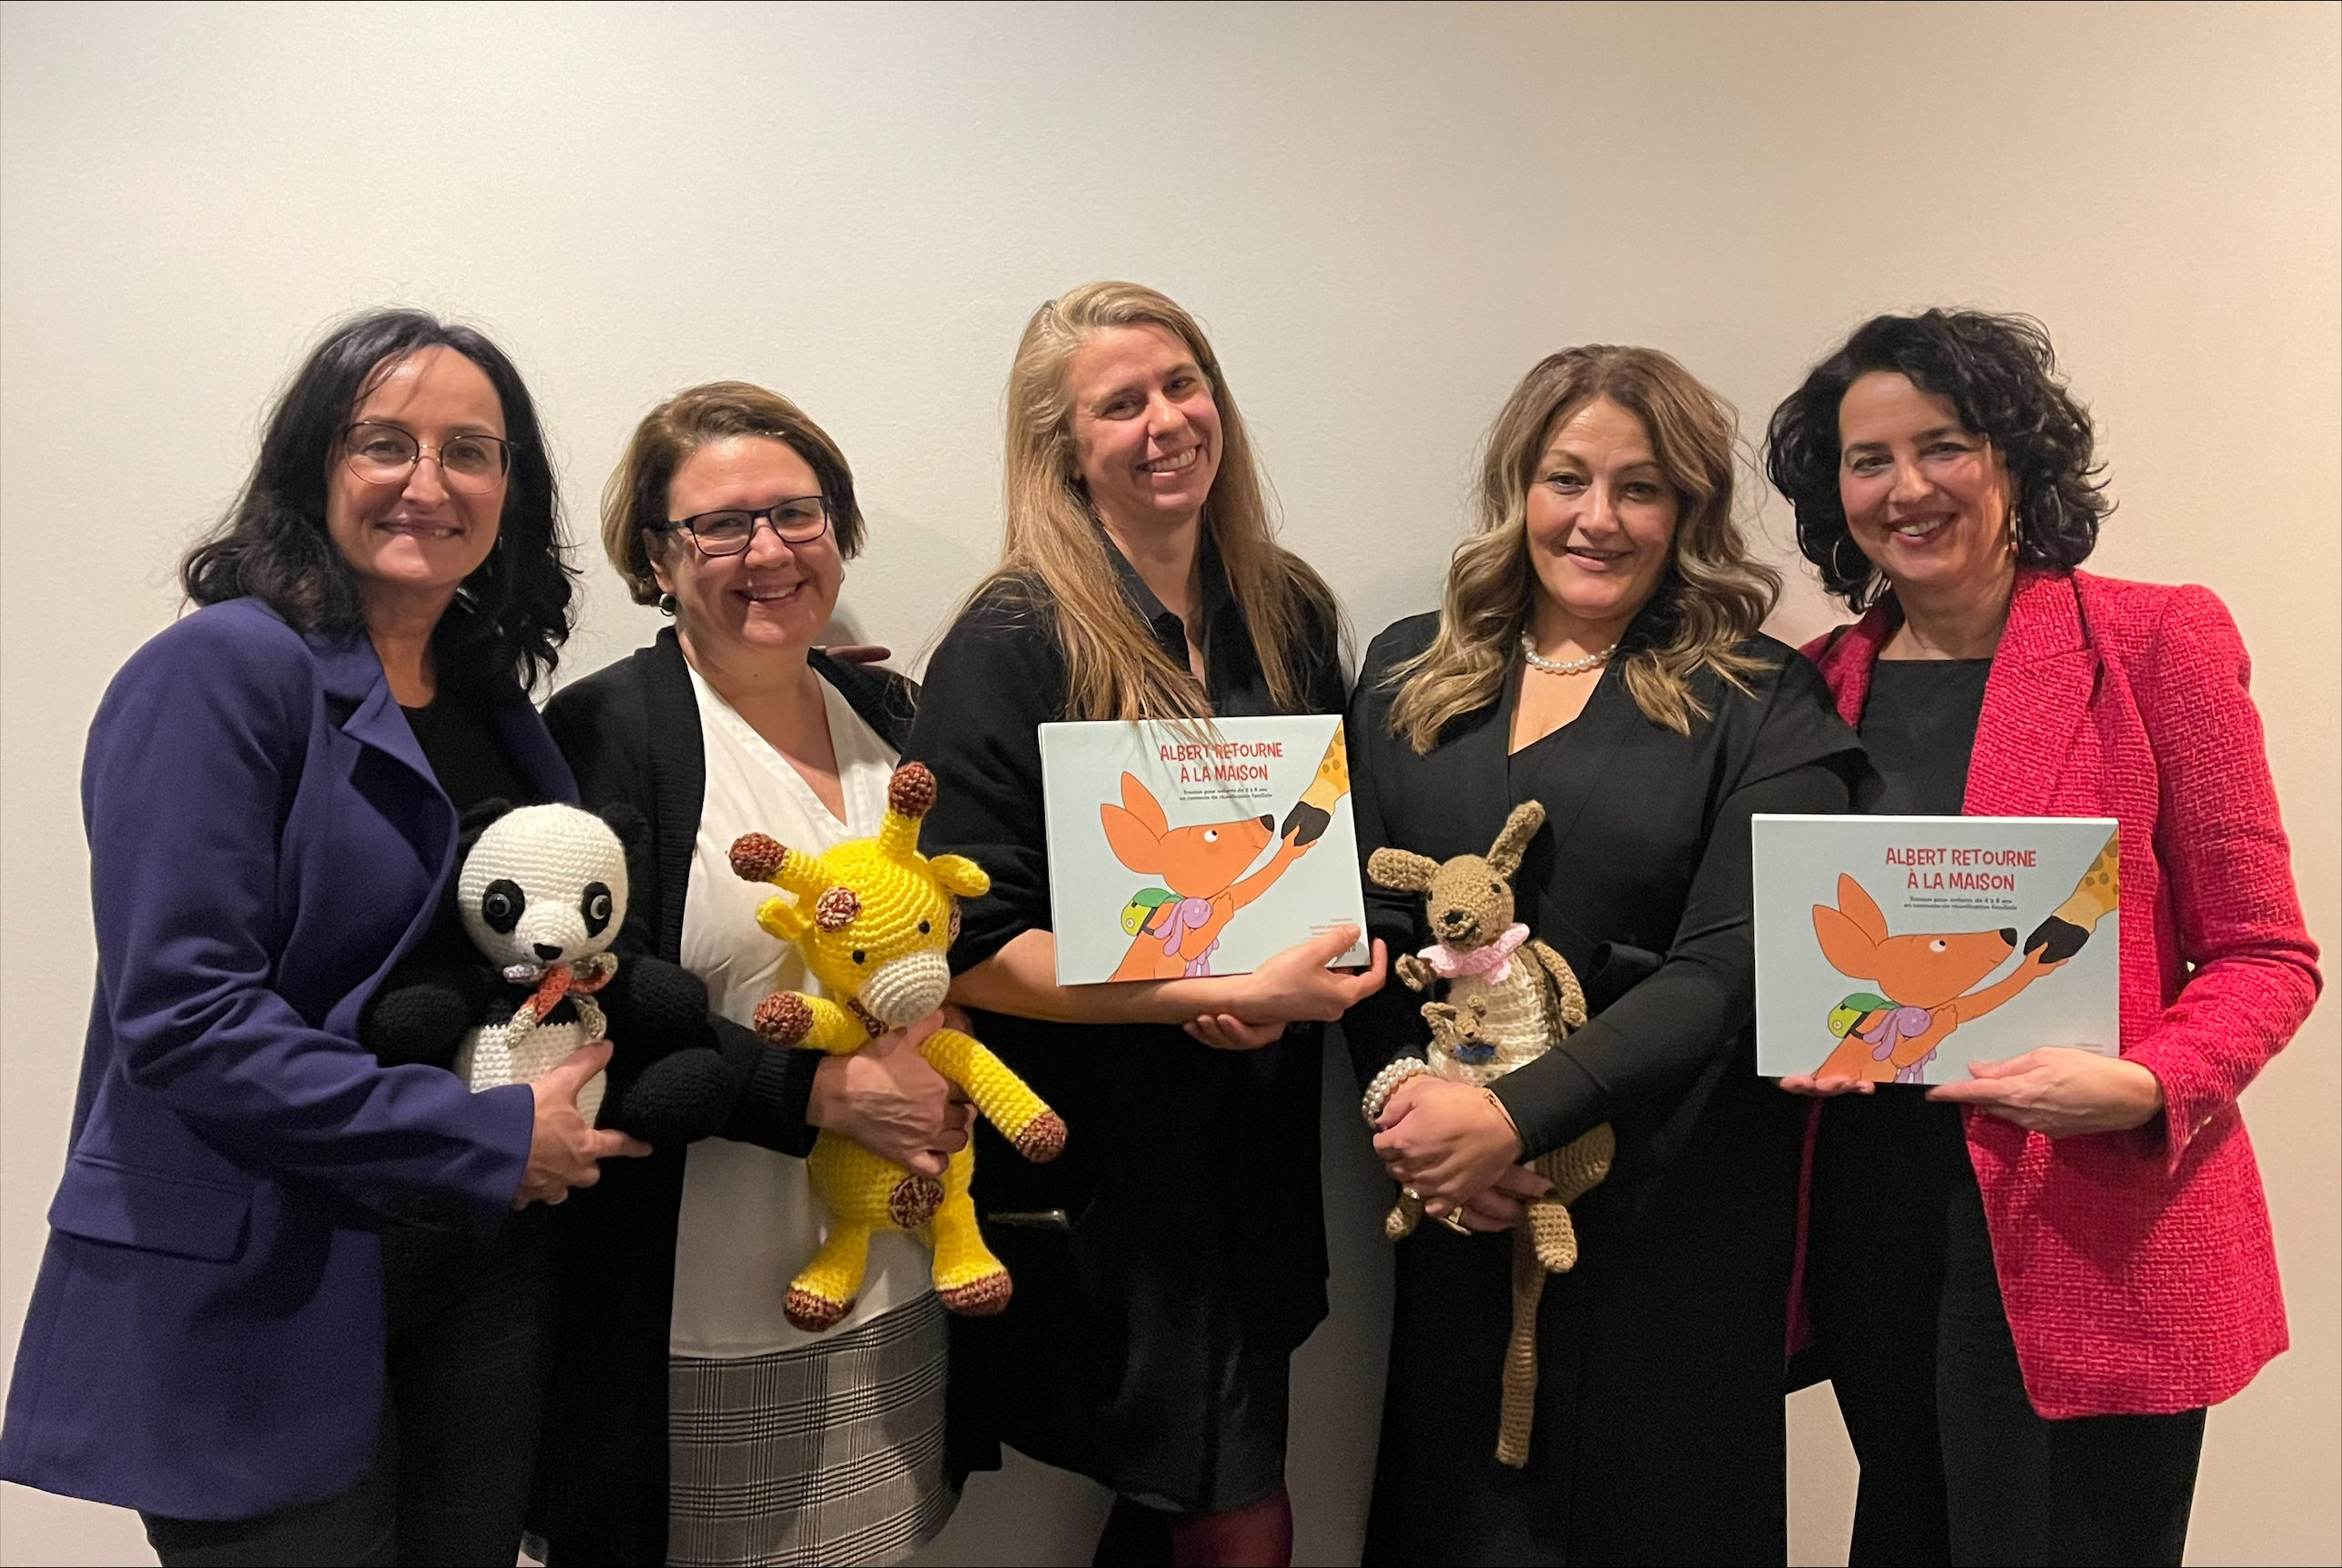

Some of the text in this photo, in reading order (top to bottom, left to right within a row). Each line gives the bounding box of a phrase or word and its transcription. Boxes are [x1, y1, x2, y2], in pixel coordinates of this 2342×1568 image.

[1161, 742, 1283, 761] ALBERT RETOURNE
[1181, 764, 1268, 783] À LA MAISON
[1886, 847, 2037, 867] ALBERT RETOURNE
[1907, 868, 2015, 891] À LA MAISON
